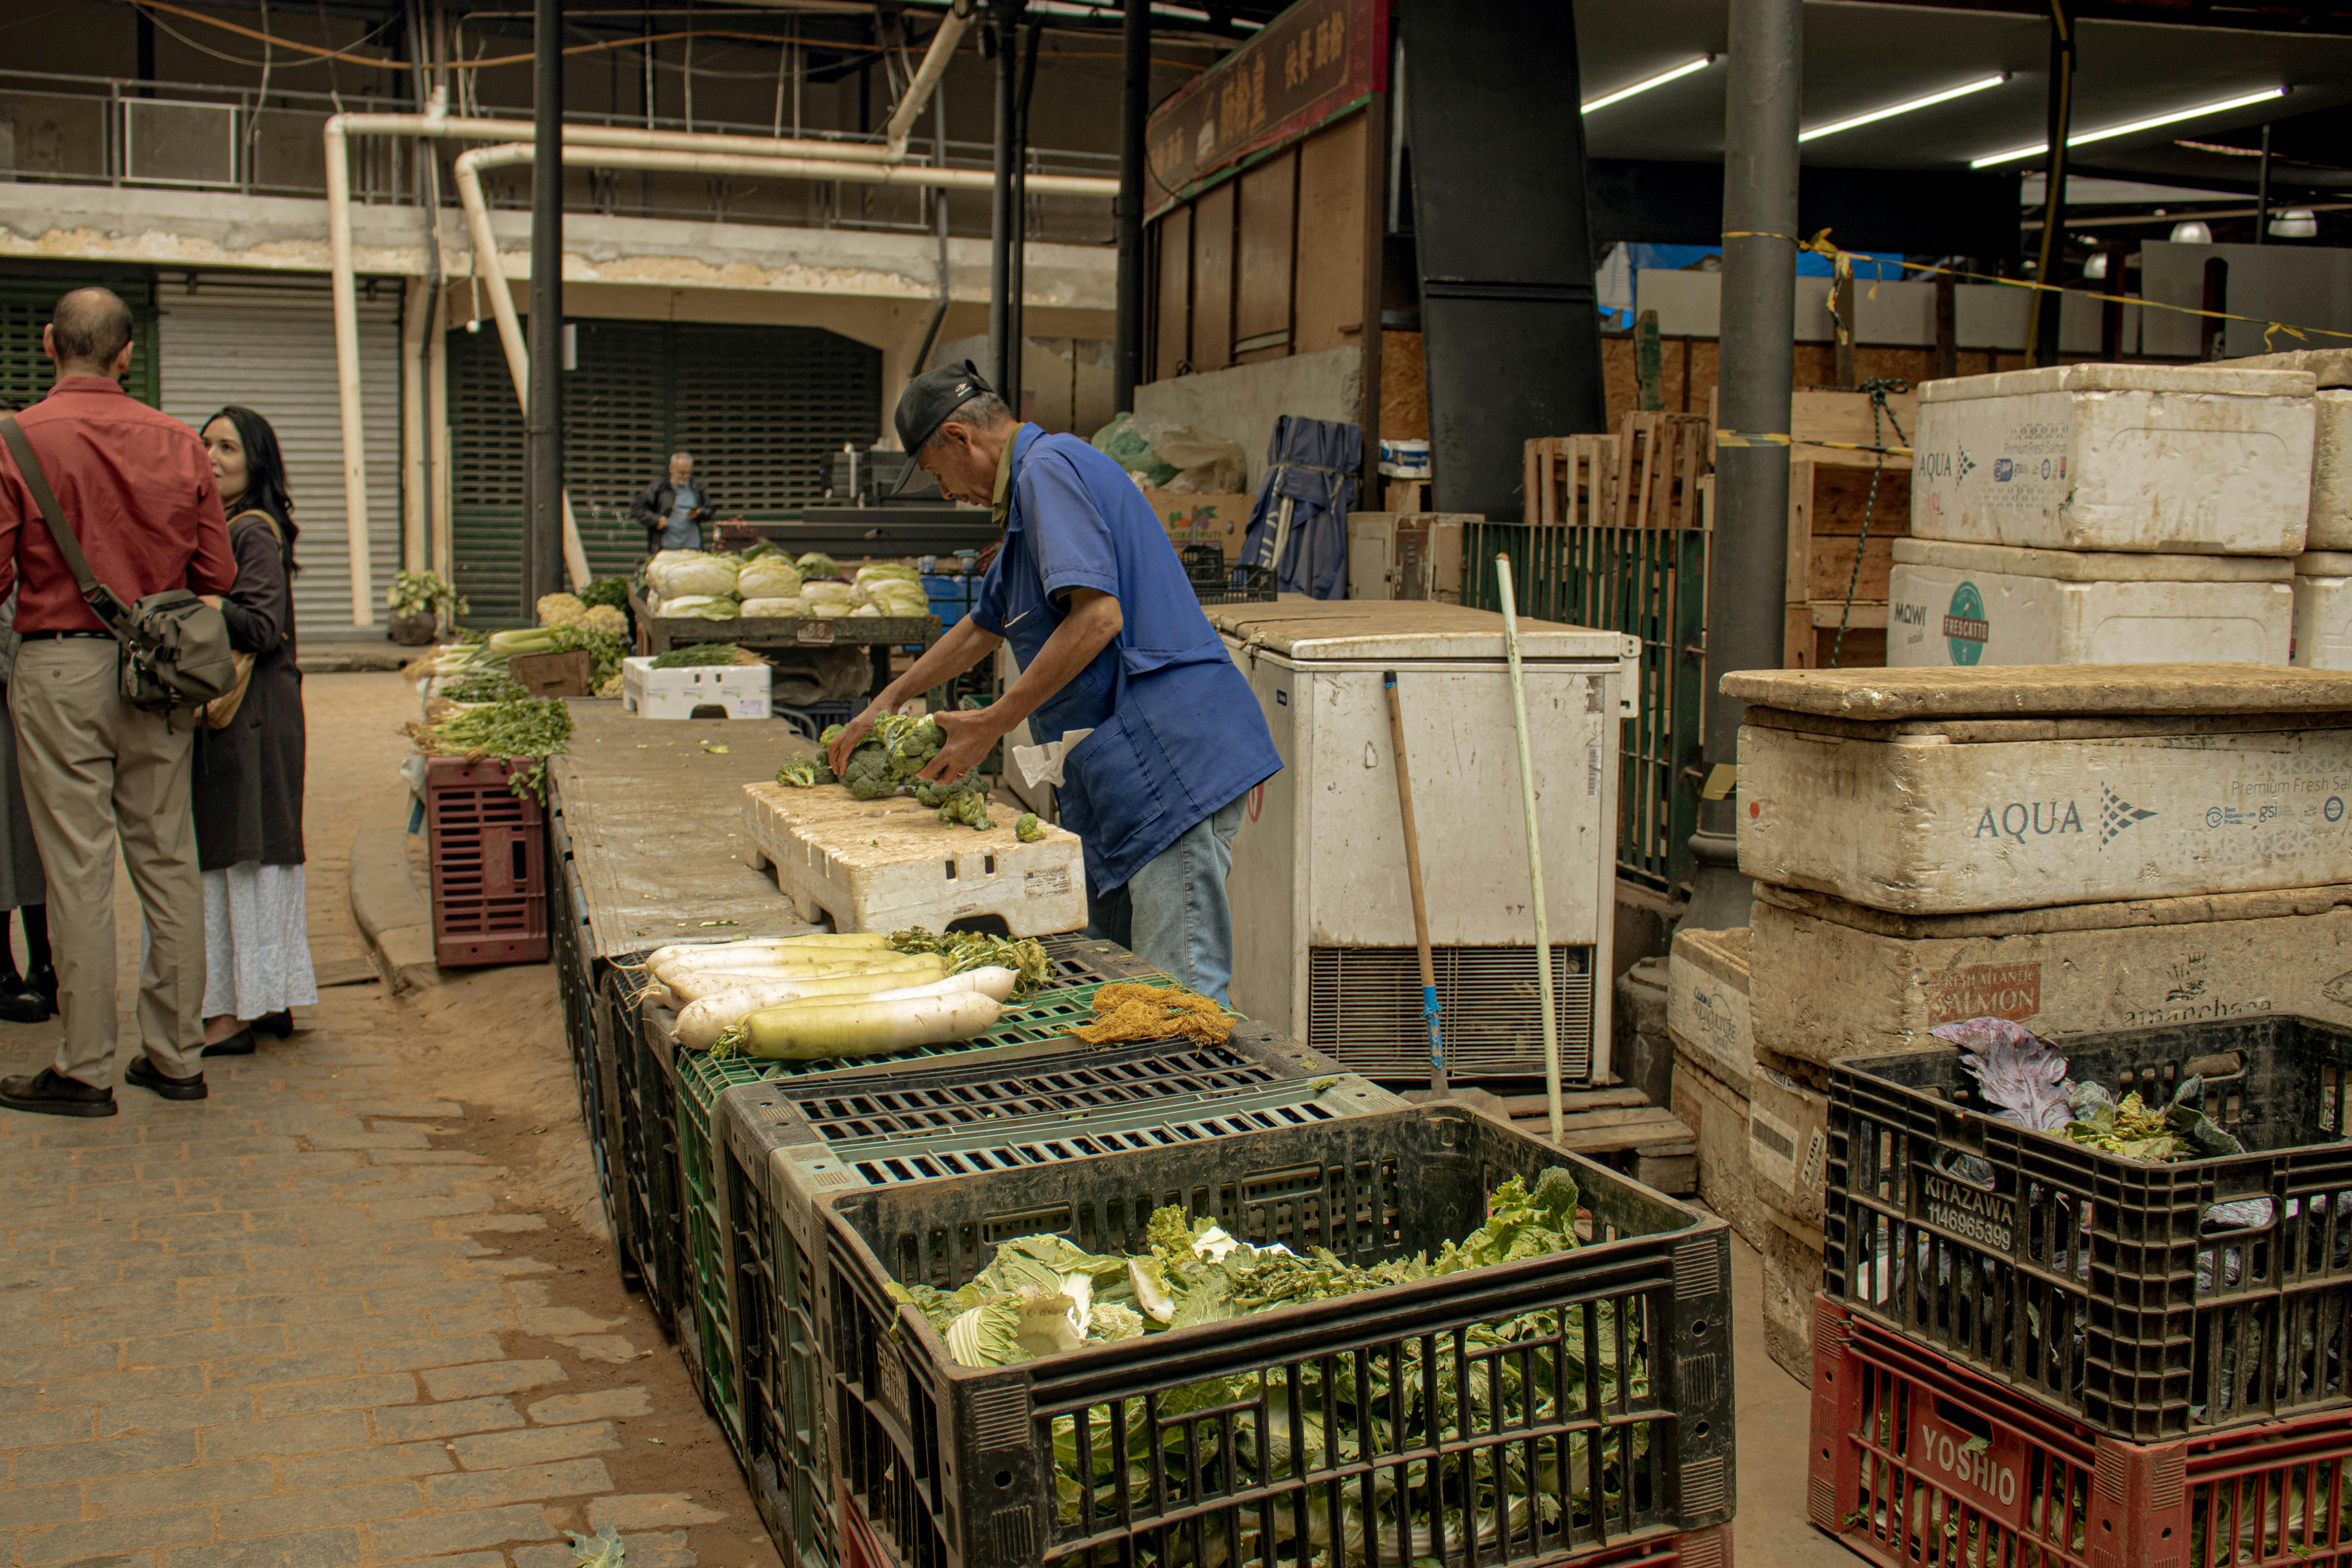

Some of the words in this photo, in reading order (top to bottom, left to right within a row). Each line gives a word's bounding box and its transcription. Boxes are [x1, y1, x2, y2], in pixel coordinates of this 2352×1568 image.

[1919, 453, 1952, 482] AQUA
[1945, 618, 1987, 641] FRESCATTO
[2232, 780, 2290, 795] Premium
[2294, 777, 2328, 792] Fresh
[2332, 775, 2352, 791] Sal
[1973, 800, 2084, 844] AQUA
[1931, 986, 2034, 1016] SALMON
[1925, 1174, 2013, 1226] KITAZAWA
[1928, 1202, 2011, 1251] 1146965399
[881, 1368, 912, 1425] IBIUNA
[1923, 1424, 2015, 1505] YOSHIO
